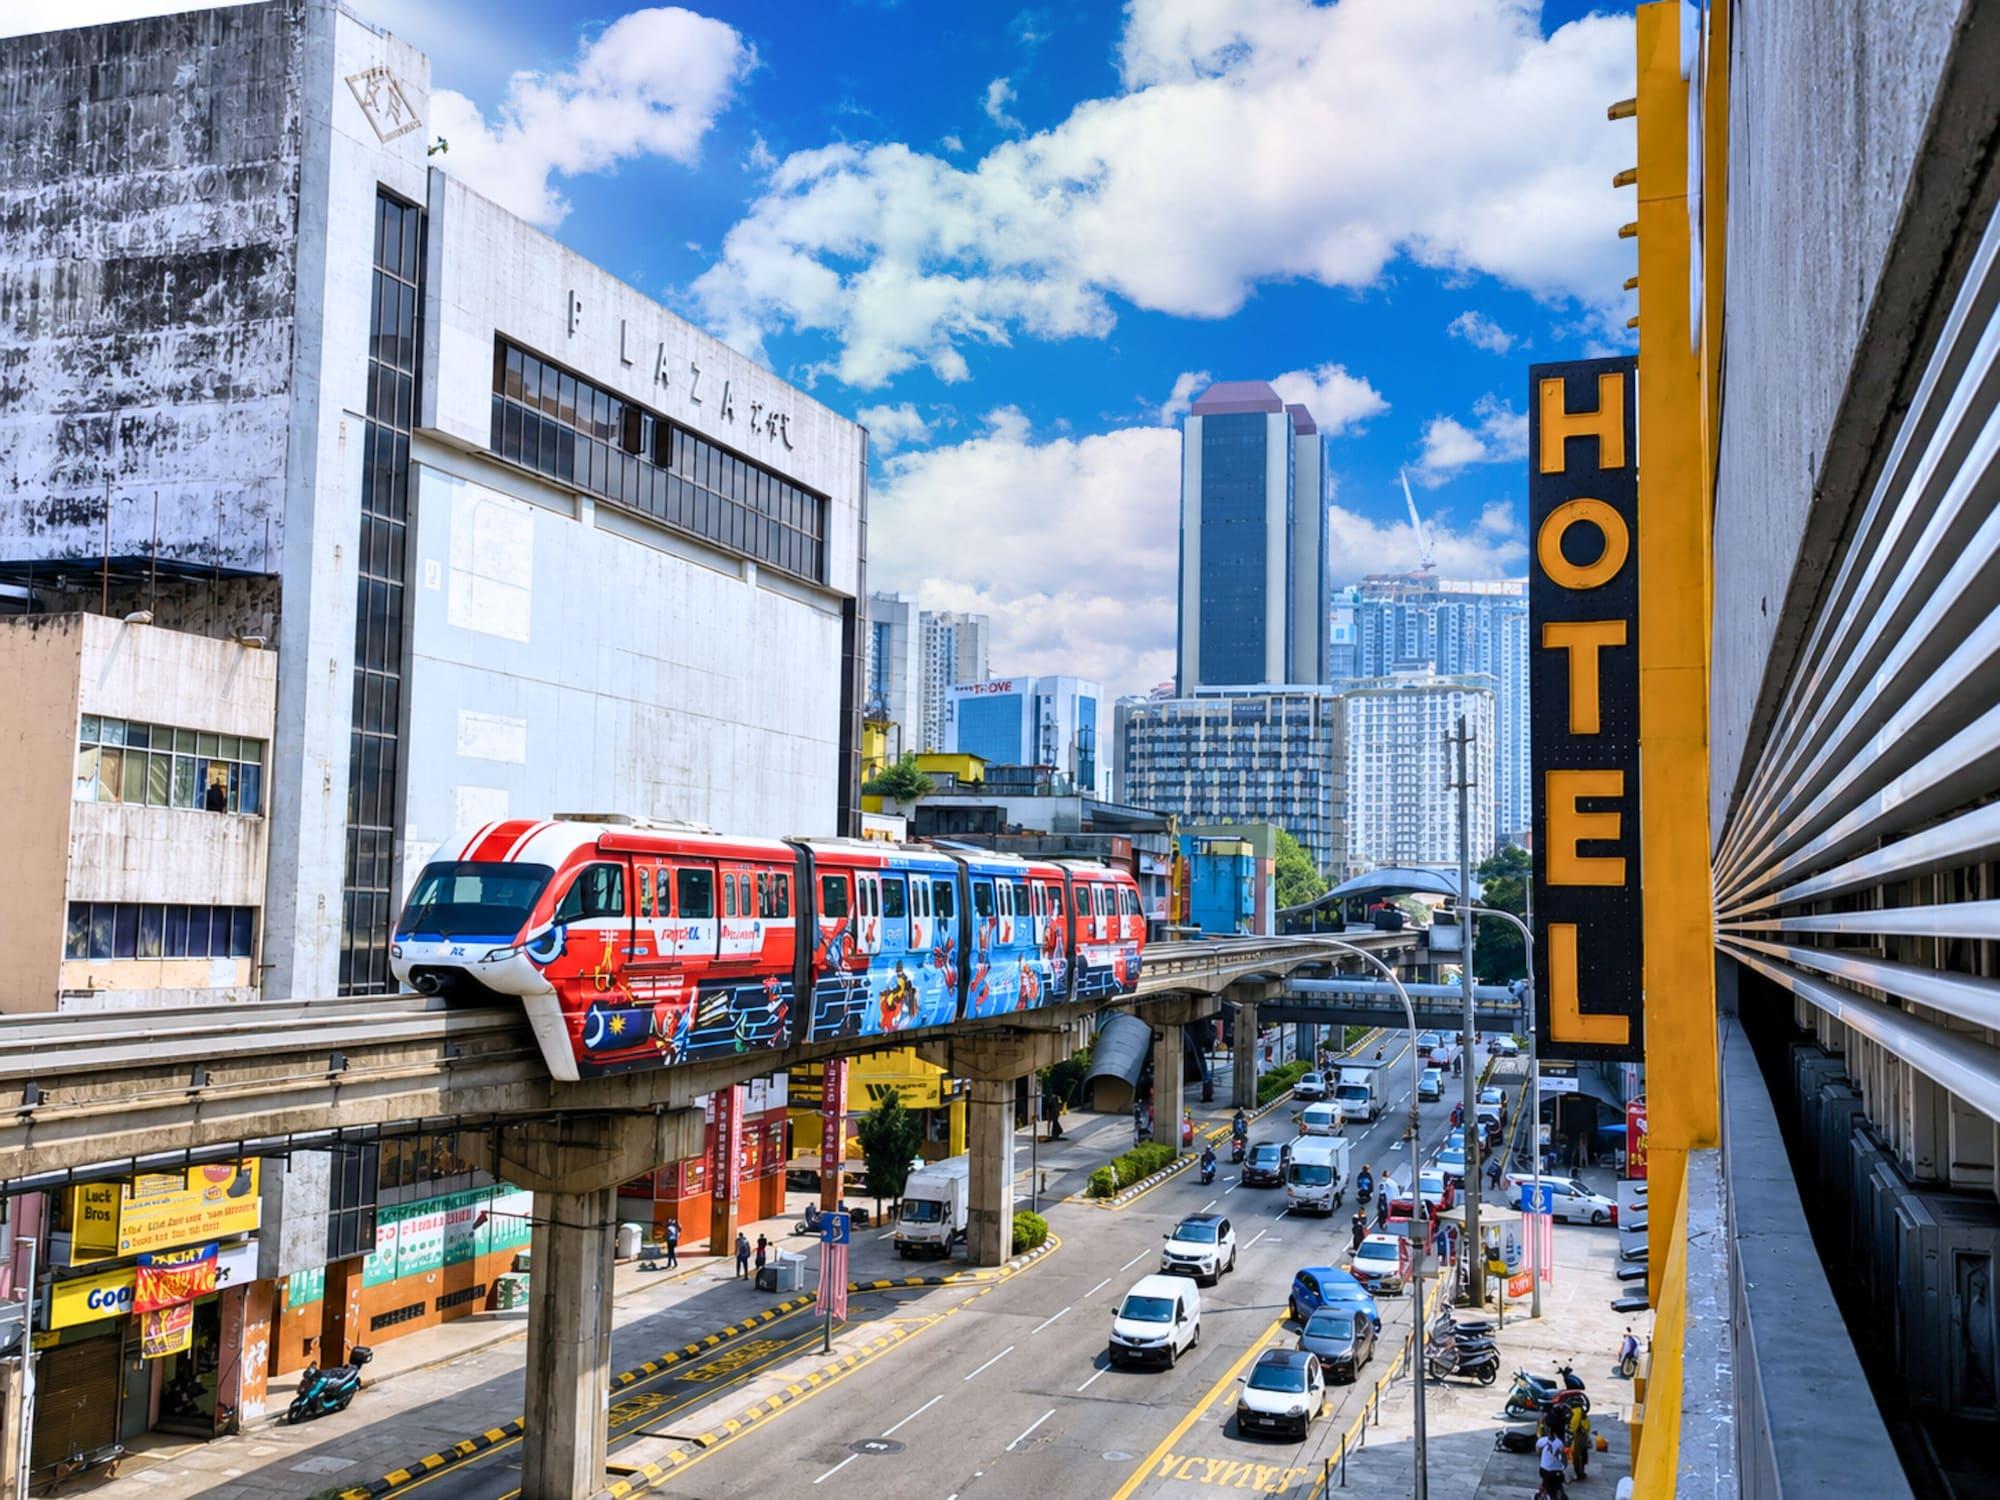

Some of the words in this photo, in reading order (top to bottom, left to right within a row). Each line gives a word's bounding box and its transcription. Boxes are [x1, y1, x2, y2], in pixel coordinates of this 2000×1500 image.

[568, 289, 735, 425] PLAZA
[1537, 373, 1630, 1046] HOTEL
[84, 1187, 112, 1204] Luck
[84, 1206, 111, 1222] Bros
